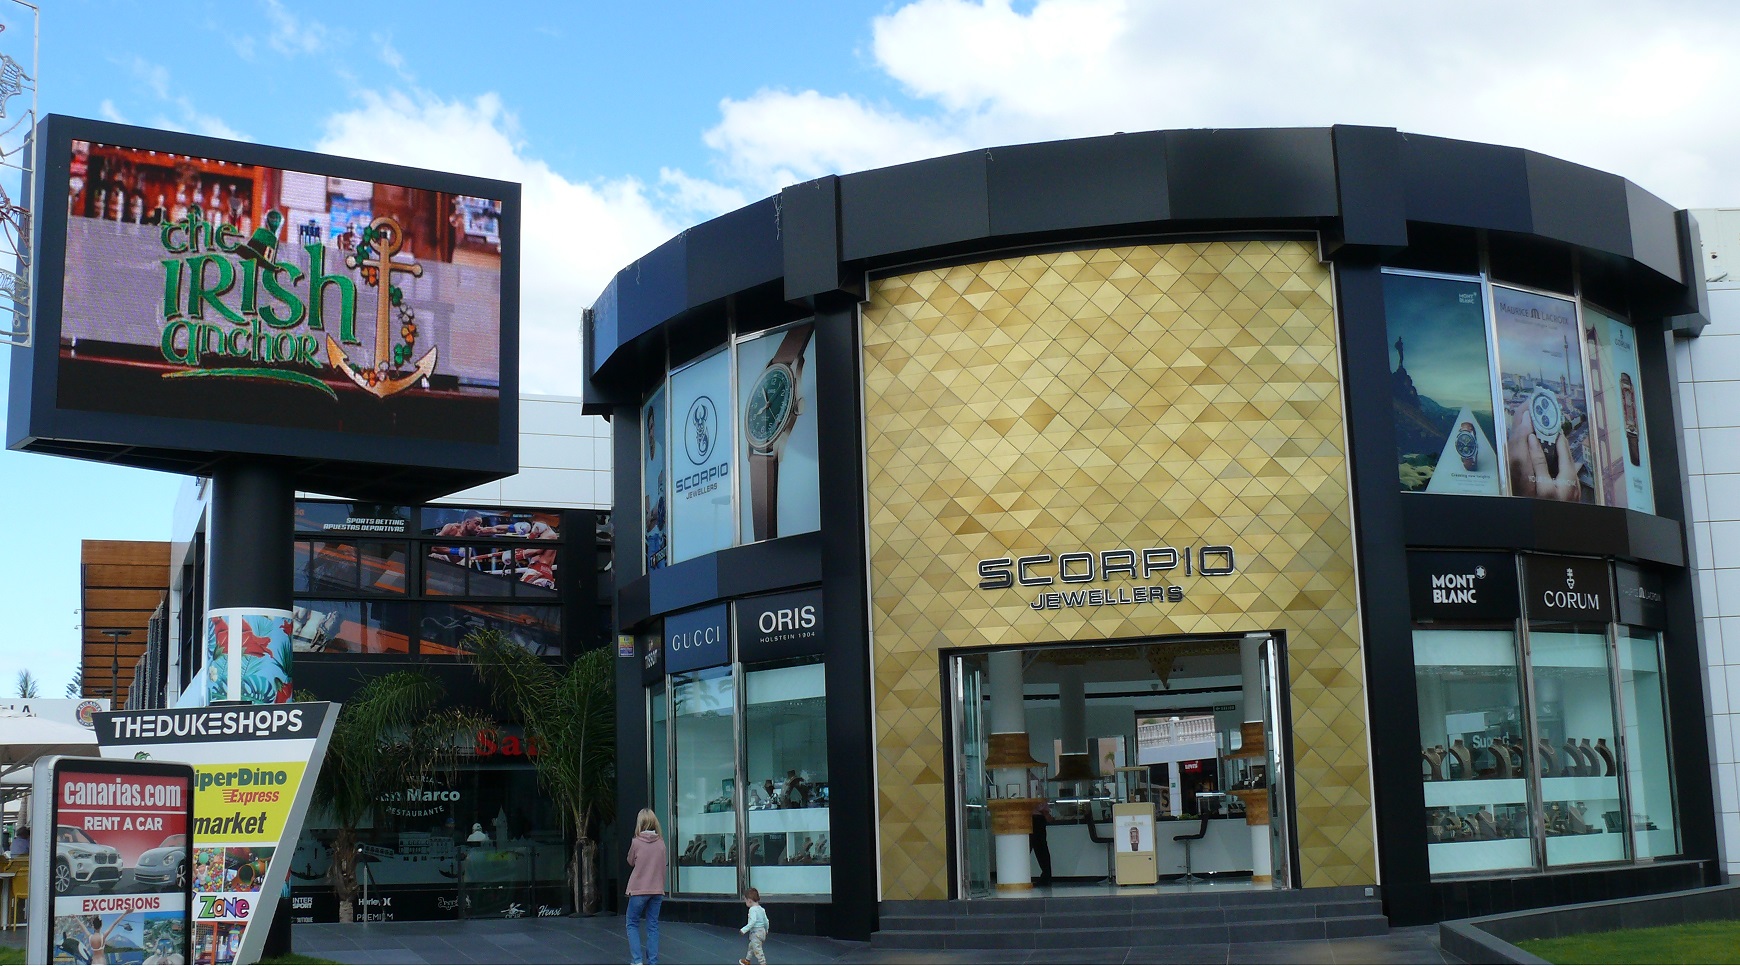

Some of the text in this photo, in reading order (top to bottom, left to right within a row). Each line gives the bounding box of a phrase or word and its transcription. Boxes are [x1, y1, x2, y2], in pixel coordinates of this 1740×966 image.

[161, 213, 245, 253] the
[676, 462, 729, 493] SCORPIO
[685, 482, 718, 500] JEWELLERS
[323, 523, 405, 533] APUESTAS DEPORTIVAS
[346, 517, 374, 525] SPORTS
[976, 544, 1236, 590] SCORPIO
[1431, 573, 1476, 589] MONT
[1029, 585, 1185, 611] JEWELLERS
[1432, 588, 1478, 604] BLANC
[1543, 589, 1600, 611] CORUM
[758, 604, 817, 634] ORIS
[671, 625, 721, 652] GUCCI
[797, 630, 816, 639] 1904
[63, 777, 182, 807] canarias.com
[229, 788, 280, 806] Express
[406, 788, 461, 802] Marco
[84, 816, 163, 831] RENT A CAR
[82, 896, 160, 912] EXCURSIONS
